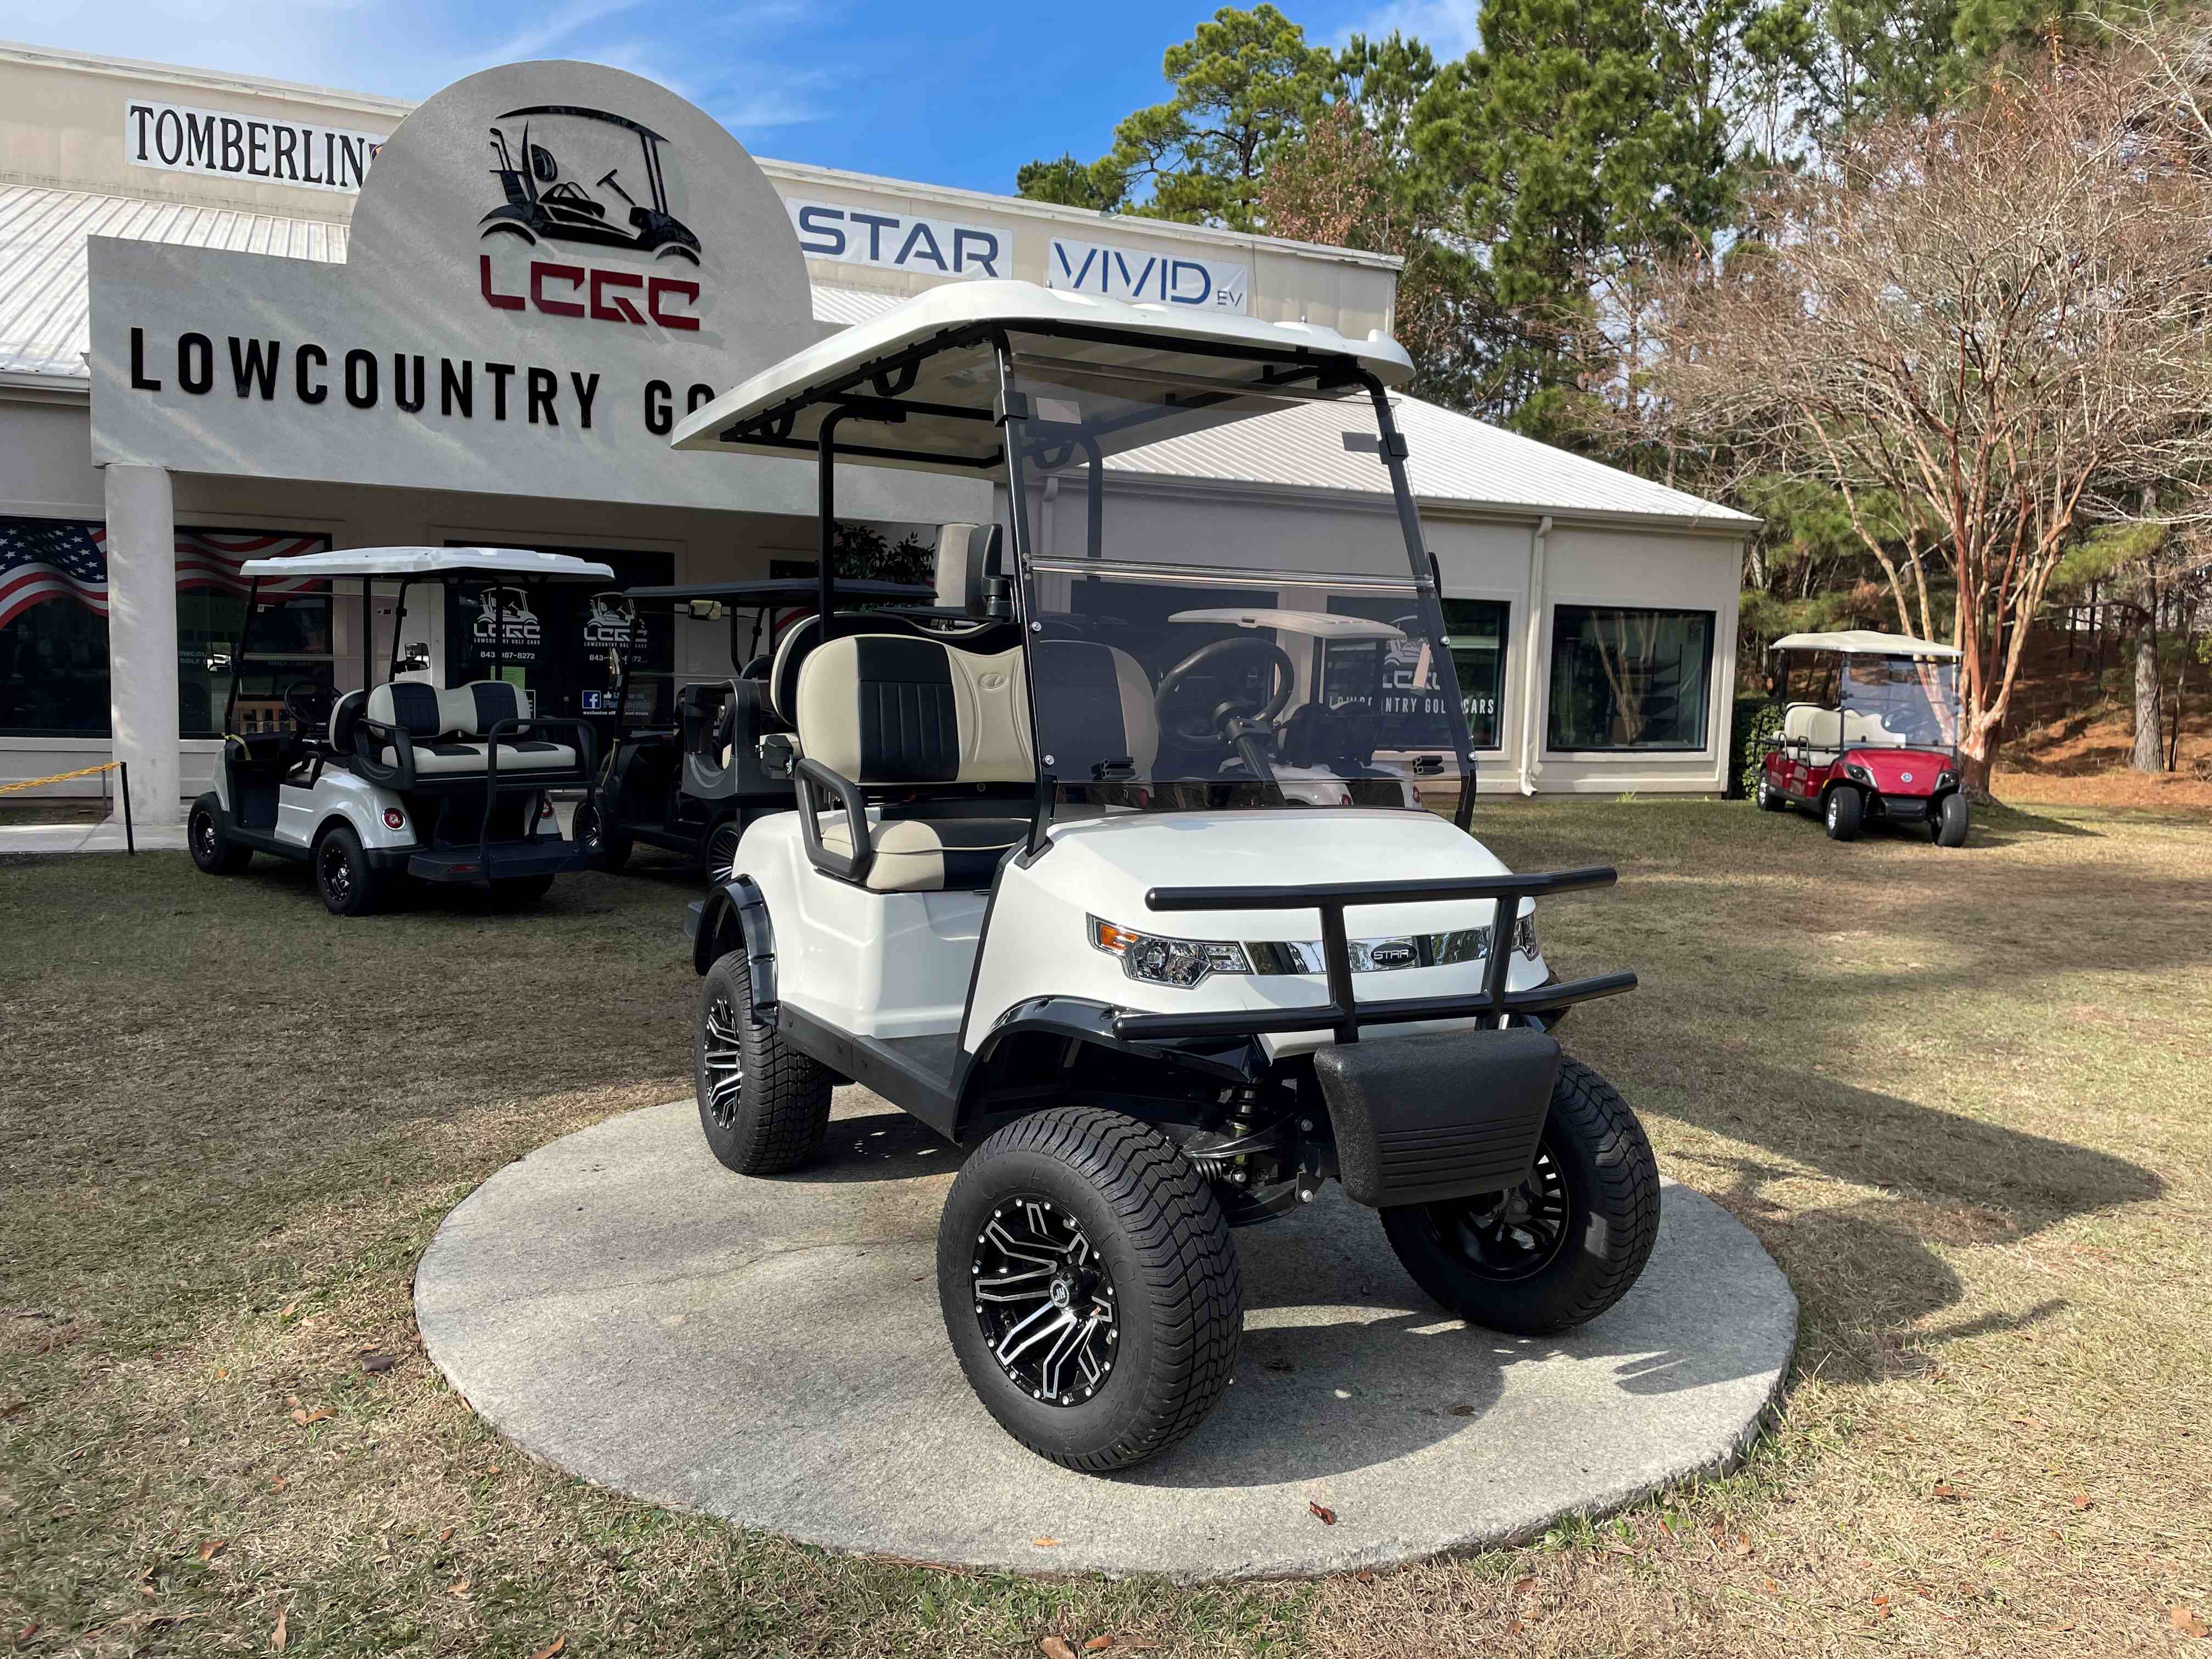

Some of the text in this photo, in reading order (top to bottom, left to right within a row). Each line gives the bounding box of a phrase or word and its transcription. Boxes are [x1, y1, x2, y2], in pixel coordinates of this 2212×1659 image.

[130, 105, 365, 188] TOMBERLIN
[799, 206, 1000, 278] STAR
[1053, 242, 1243, 307] VIVID EV
[130, 326, 715, 435] LOWCOUNTRY GO
[1463, 698, 1494, 714] CARS
[1373, 949, 1409, 960] STAR
